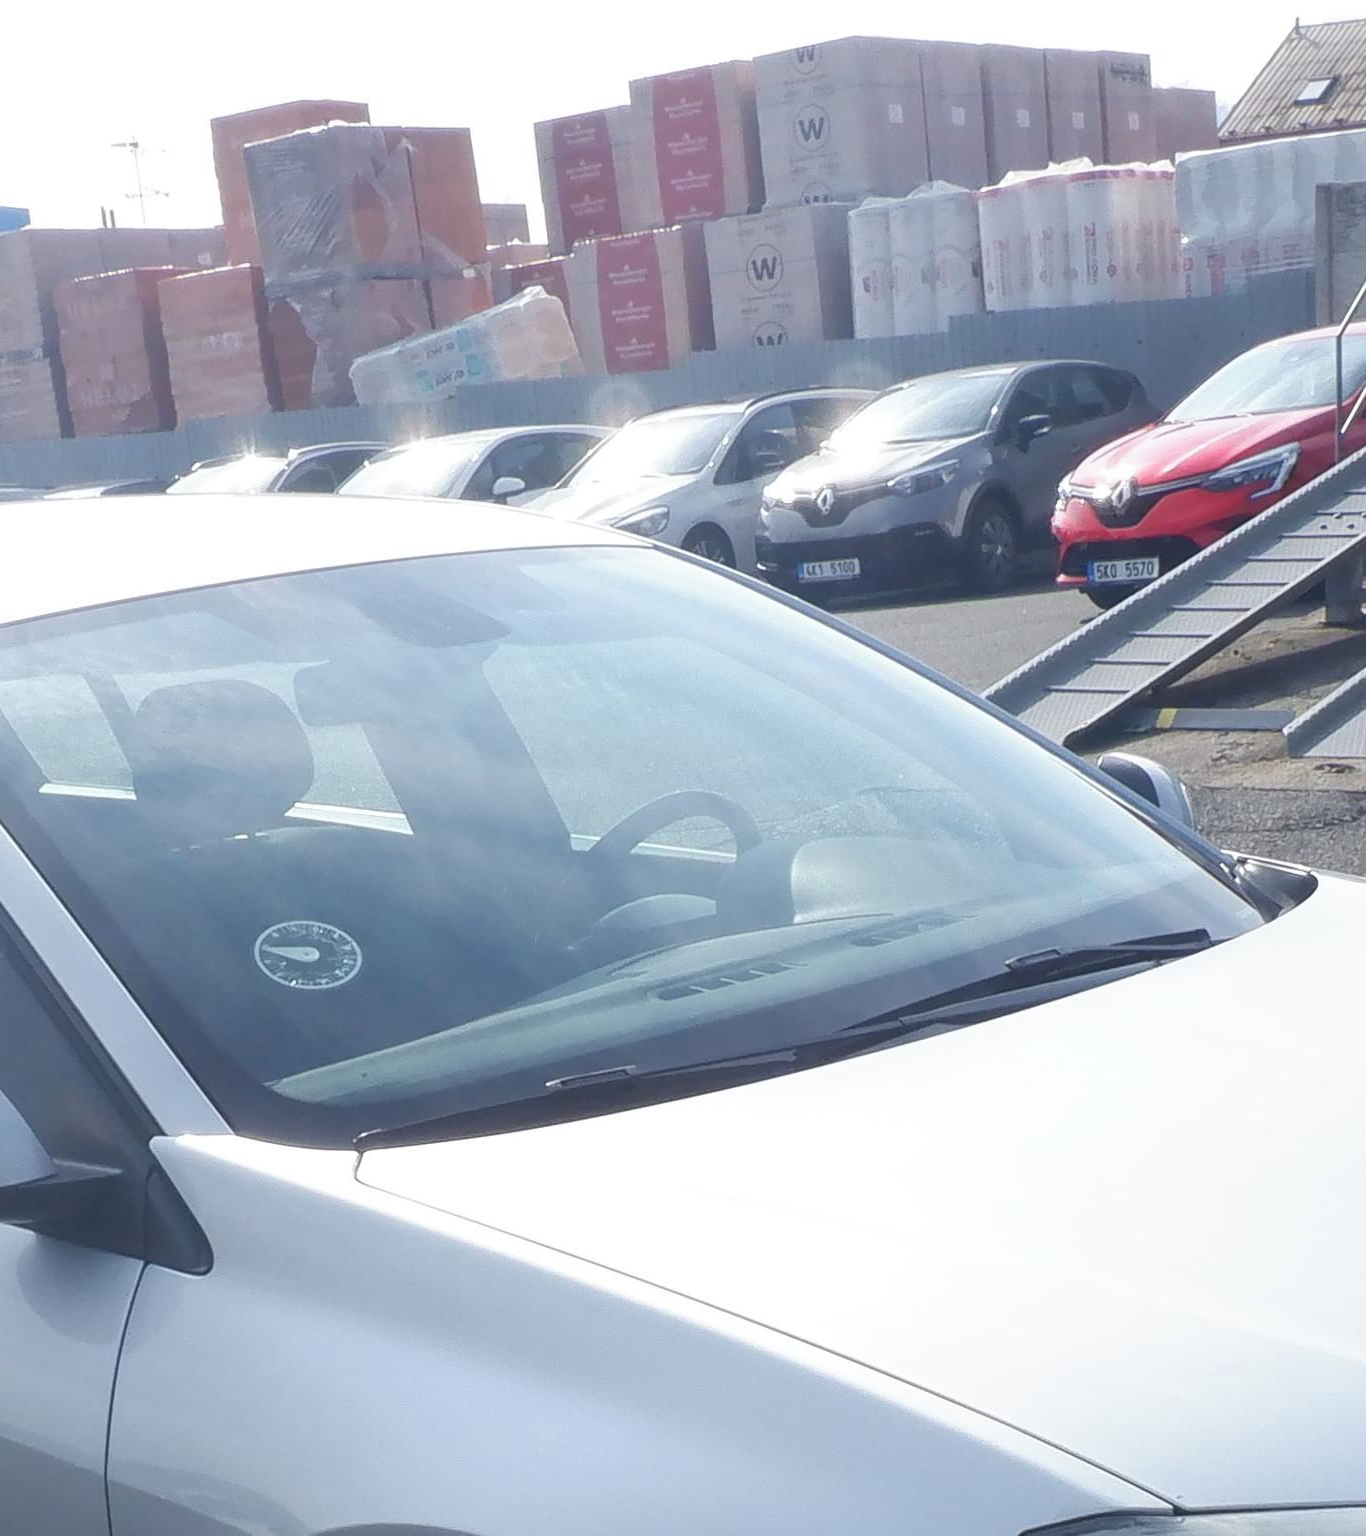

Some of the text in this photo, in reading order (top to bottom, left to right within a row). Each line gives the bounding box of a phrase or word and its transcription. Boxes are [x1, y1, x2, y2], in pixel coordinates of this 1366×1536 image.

[751, 256, 778, 281] W
[1096, 561, 1154, 579] 5K0 5570
